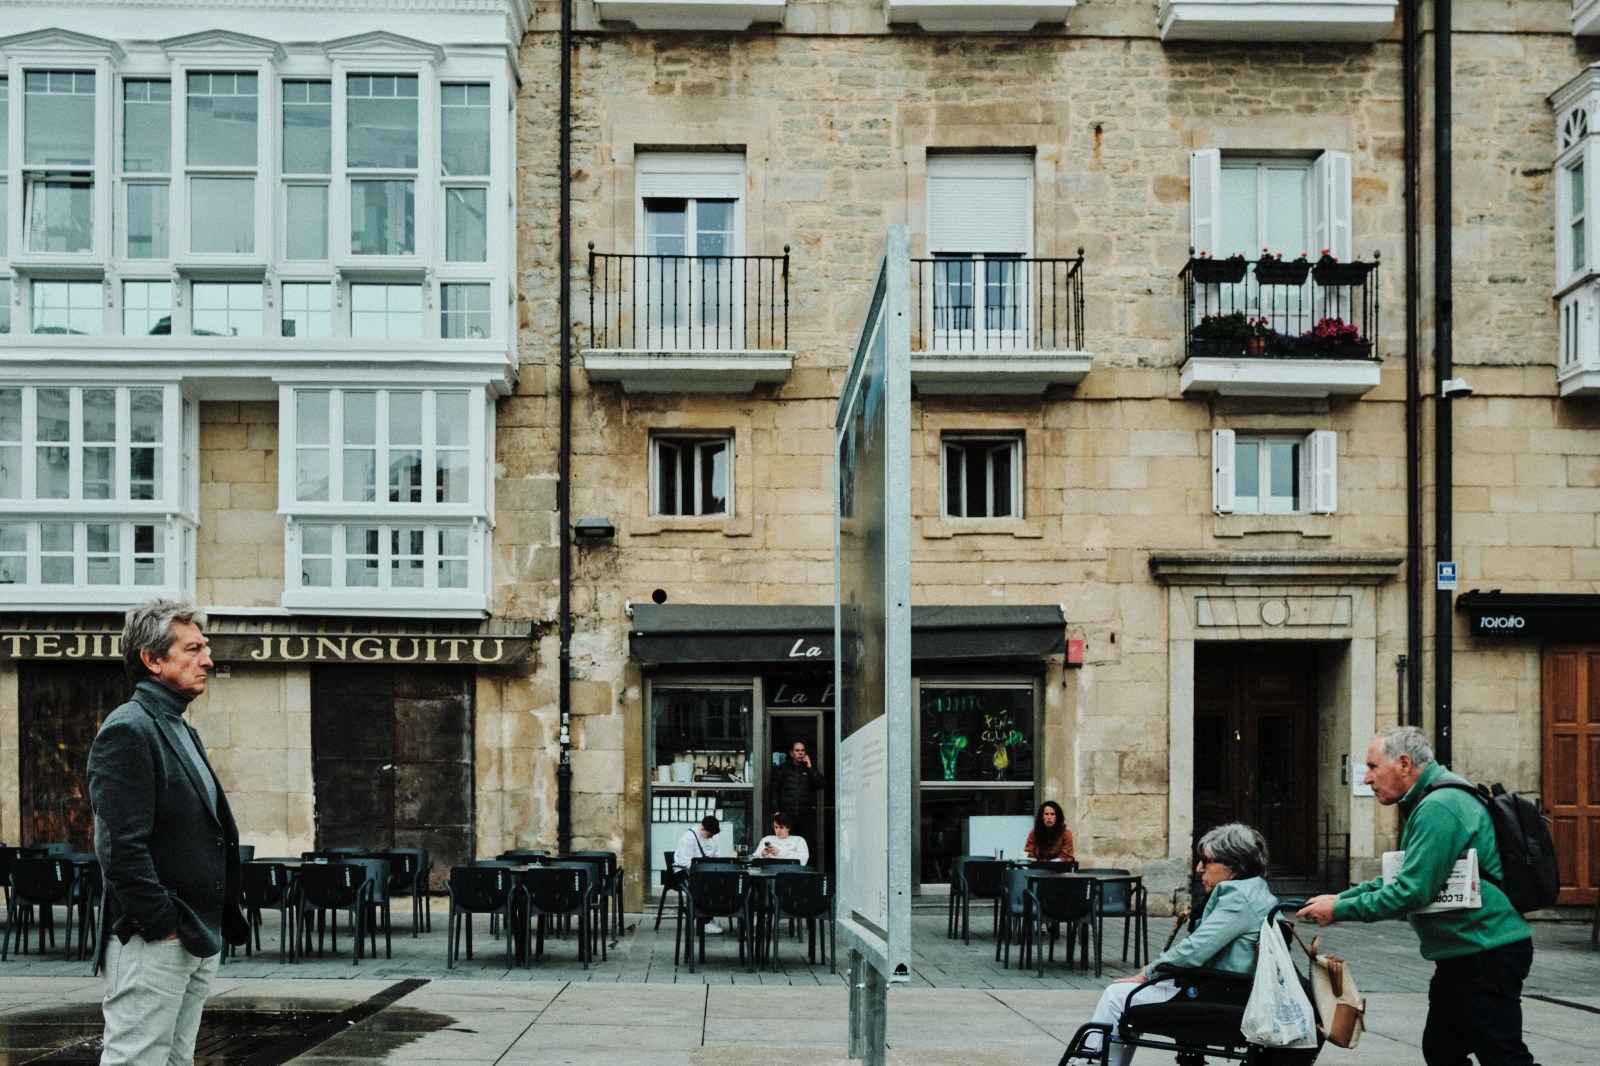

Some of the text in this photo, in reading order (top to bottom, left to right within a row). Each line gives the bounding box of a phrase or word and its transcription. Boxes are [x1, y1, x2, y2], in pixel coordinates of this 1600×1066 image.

[250, 636, 504, 662] JUNGUITU
[788, 638, 823, 657] La
[774, 683, 808, 704] La
[1454, 894, 1464, 902] EL
